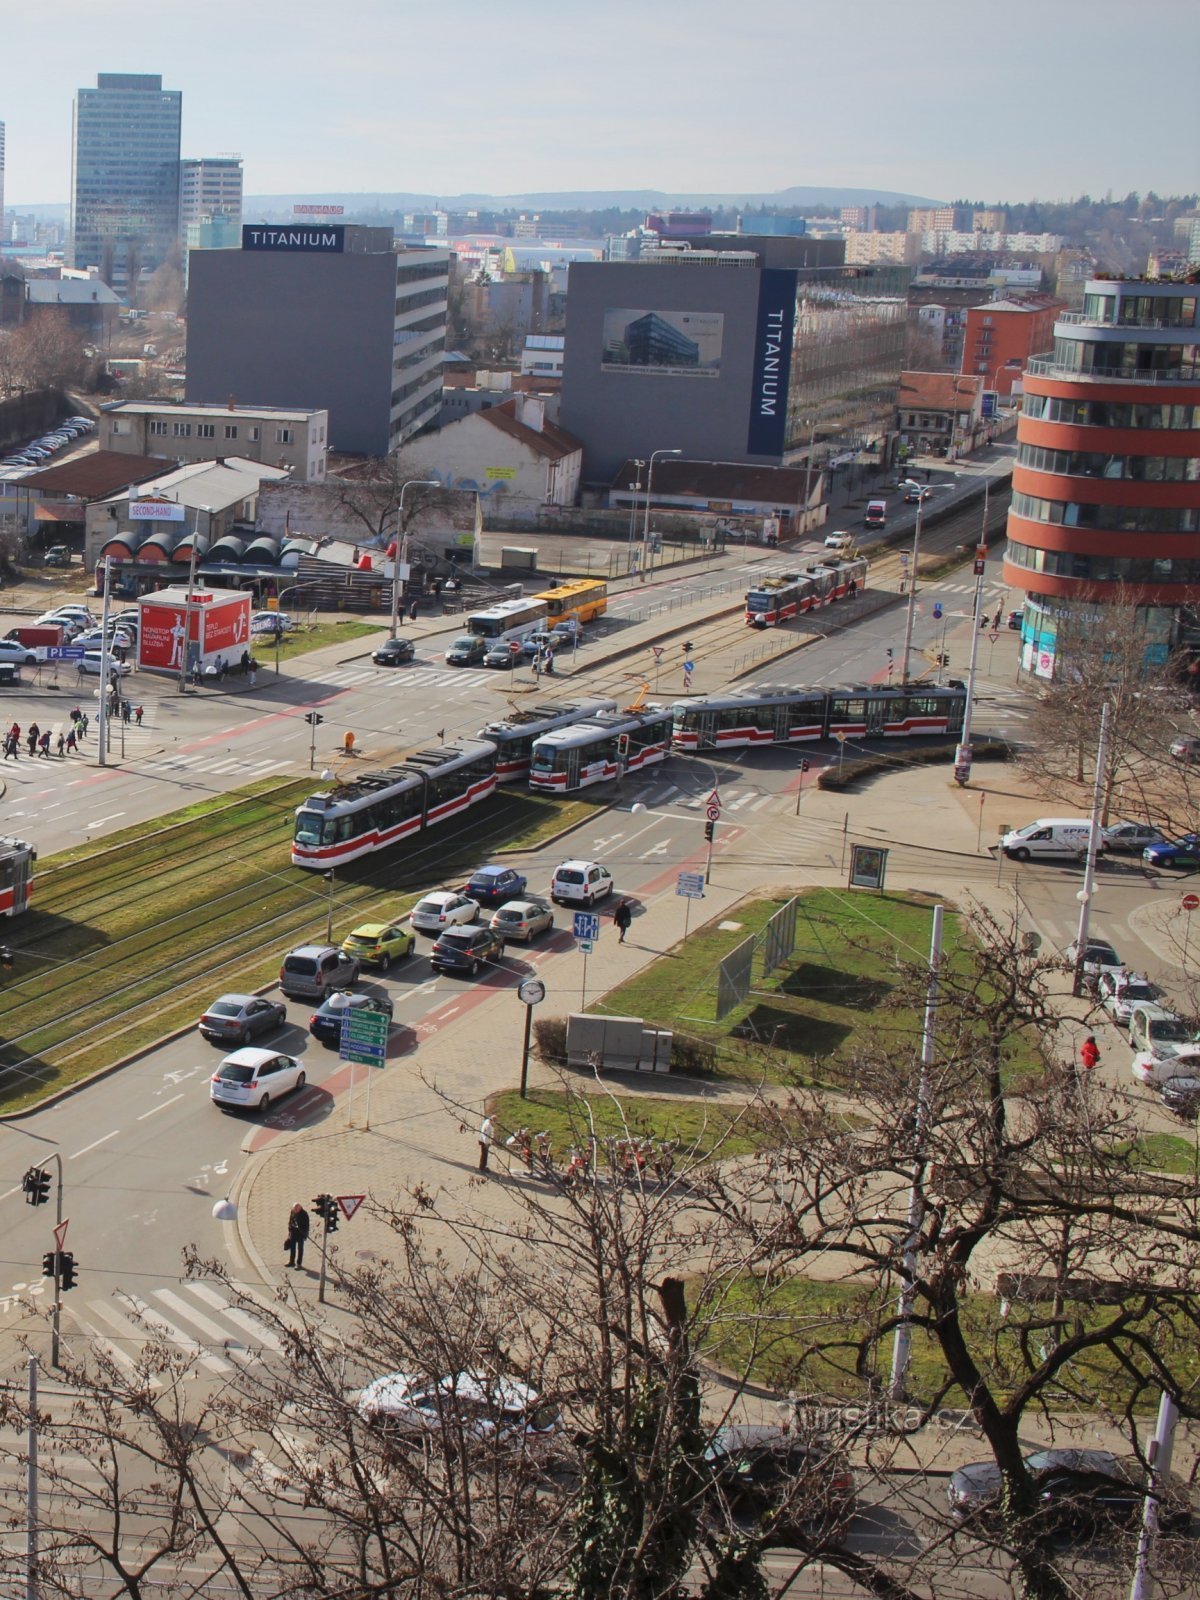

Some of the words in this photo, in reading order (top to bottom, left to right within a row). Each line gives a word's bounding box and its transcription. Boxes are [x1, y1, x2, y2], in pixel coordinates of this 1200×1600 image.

[251, 231, 337, 246] TITANIUM
[760, 309, 784, 416] TITANIUM
[132, 505, 172, 517] SECOND-HAND
[143, 626, 170, 635] NONSTOP
